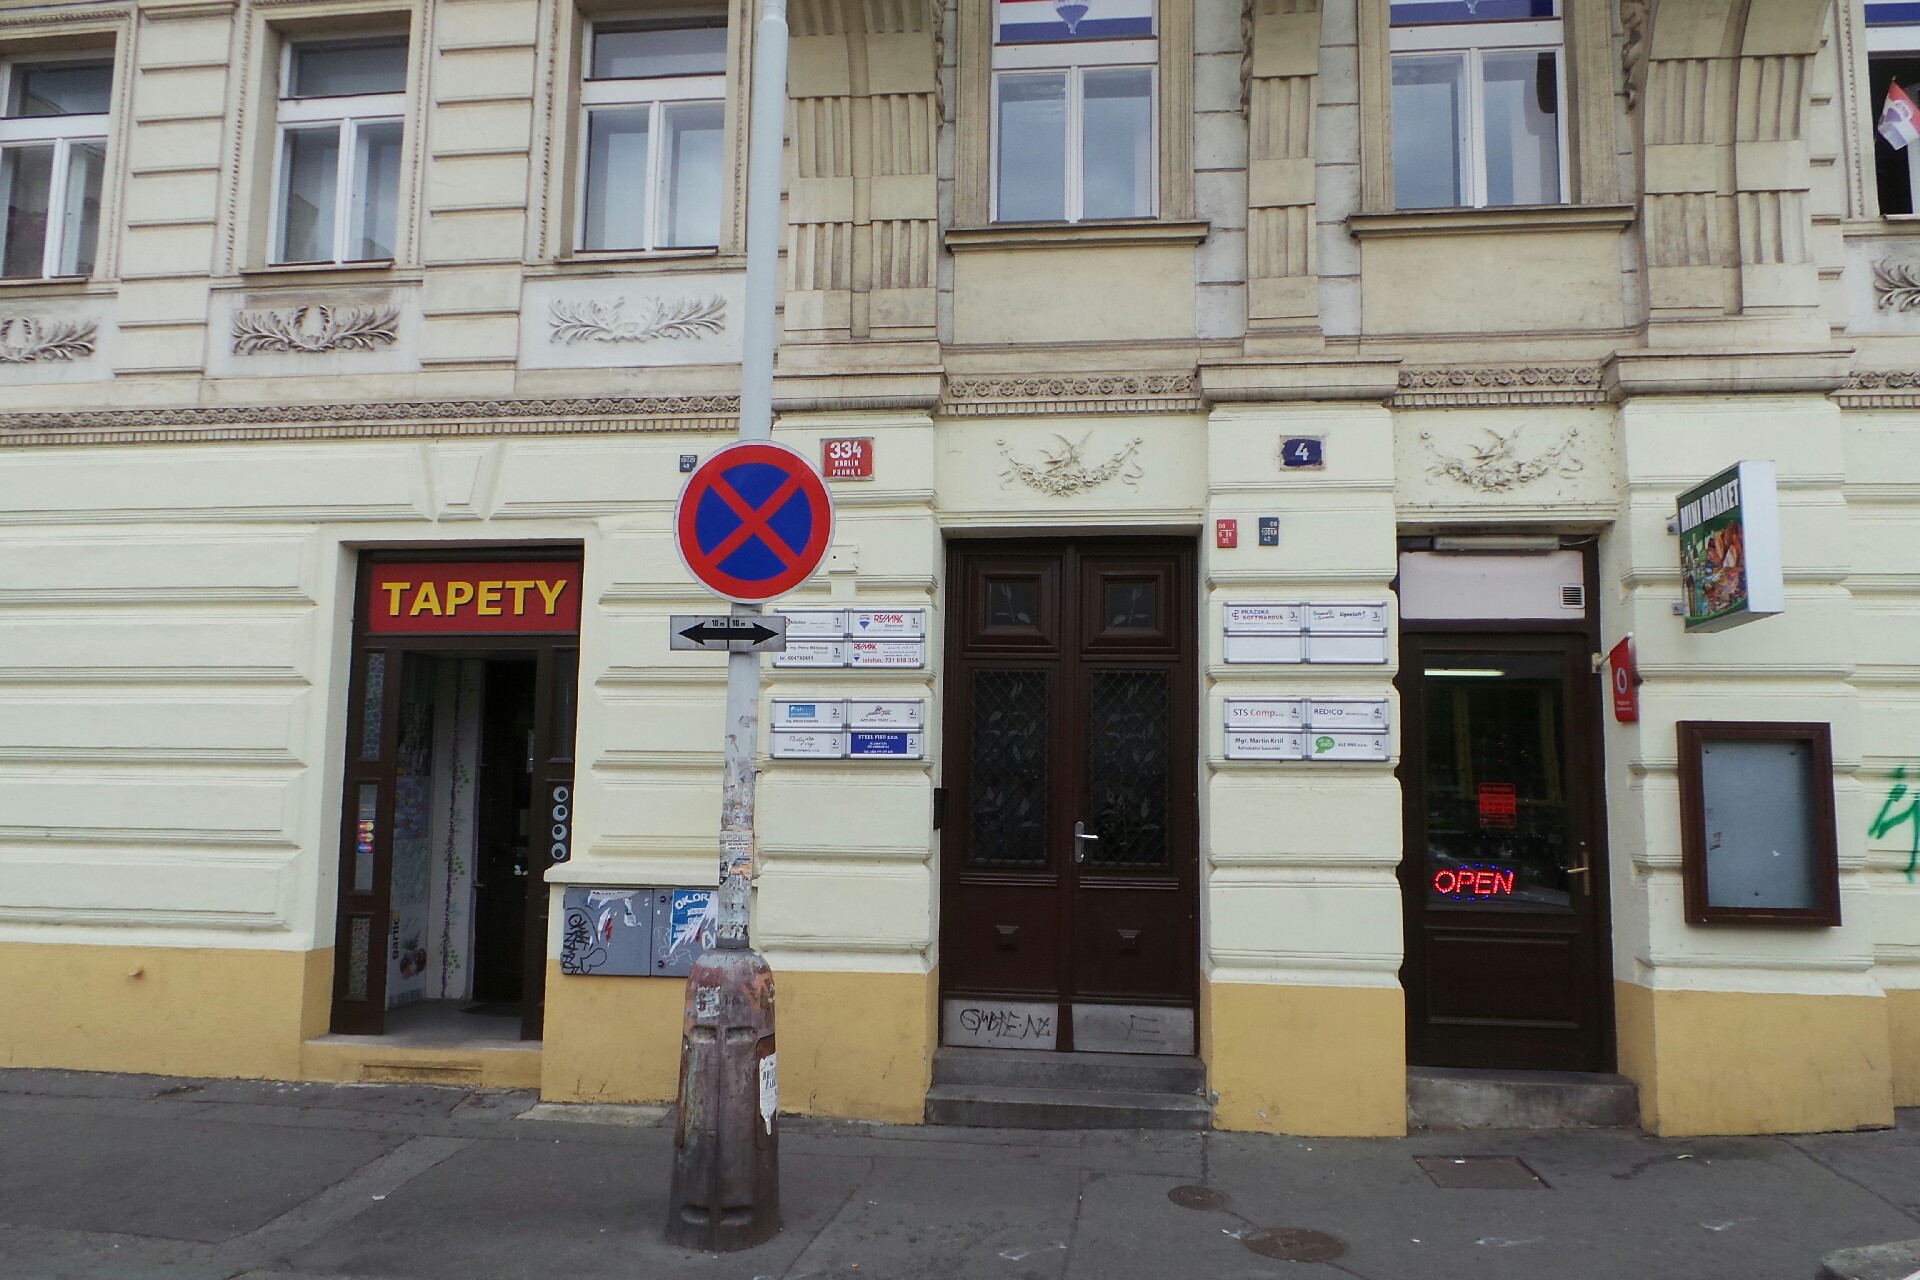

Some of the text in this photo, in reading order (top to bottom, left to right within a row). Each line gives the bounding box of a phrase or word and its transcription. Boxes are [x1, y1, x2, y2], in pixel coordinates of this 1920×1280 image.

[830, 441, 862, 458] 334
[1295, 443, 1309, 461] 4
[835, 459, 858, 467] KARLÍN
[1680, 479, 1738, 533] MINI MARKET
[382, 580, 567, 616] TAPETY
[873, 614, 903, 623] RE/MAX
[1250, 709, 1276, 718] Comp
[1435, 871, 1514, 894] OPEN
